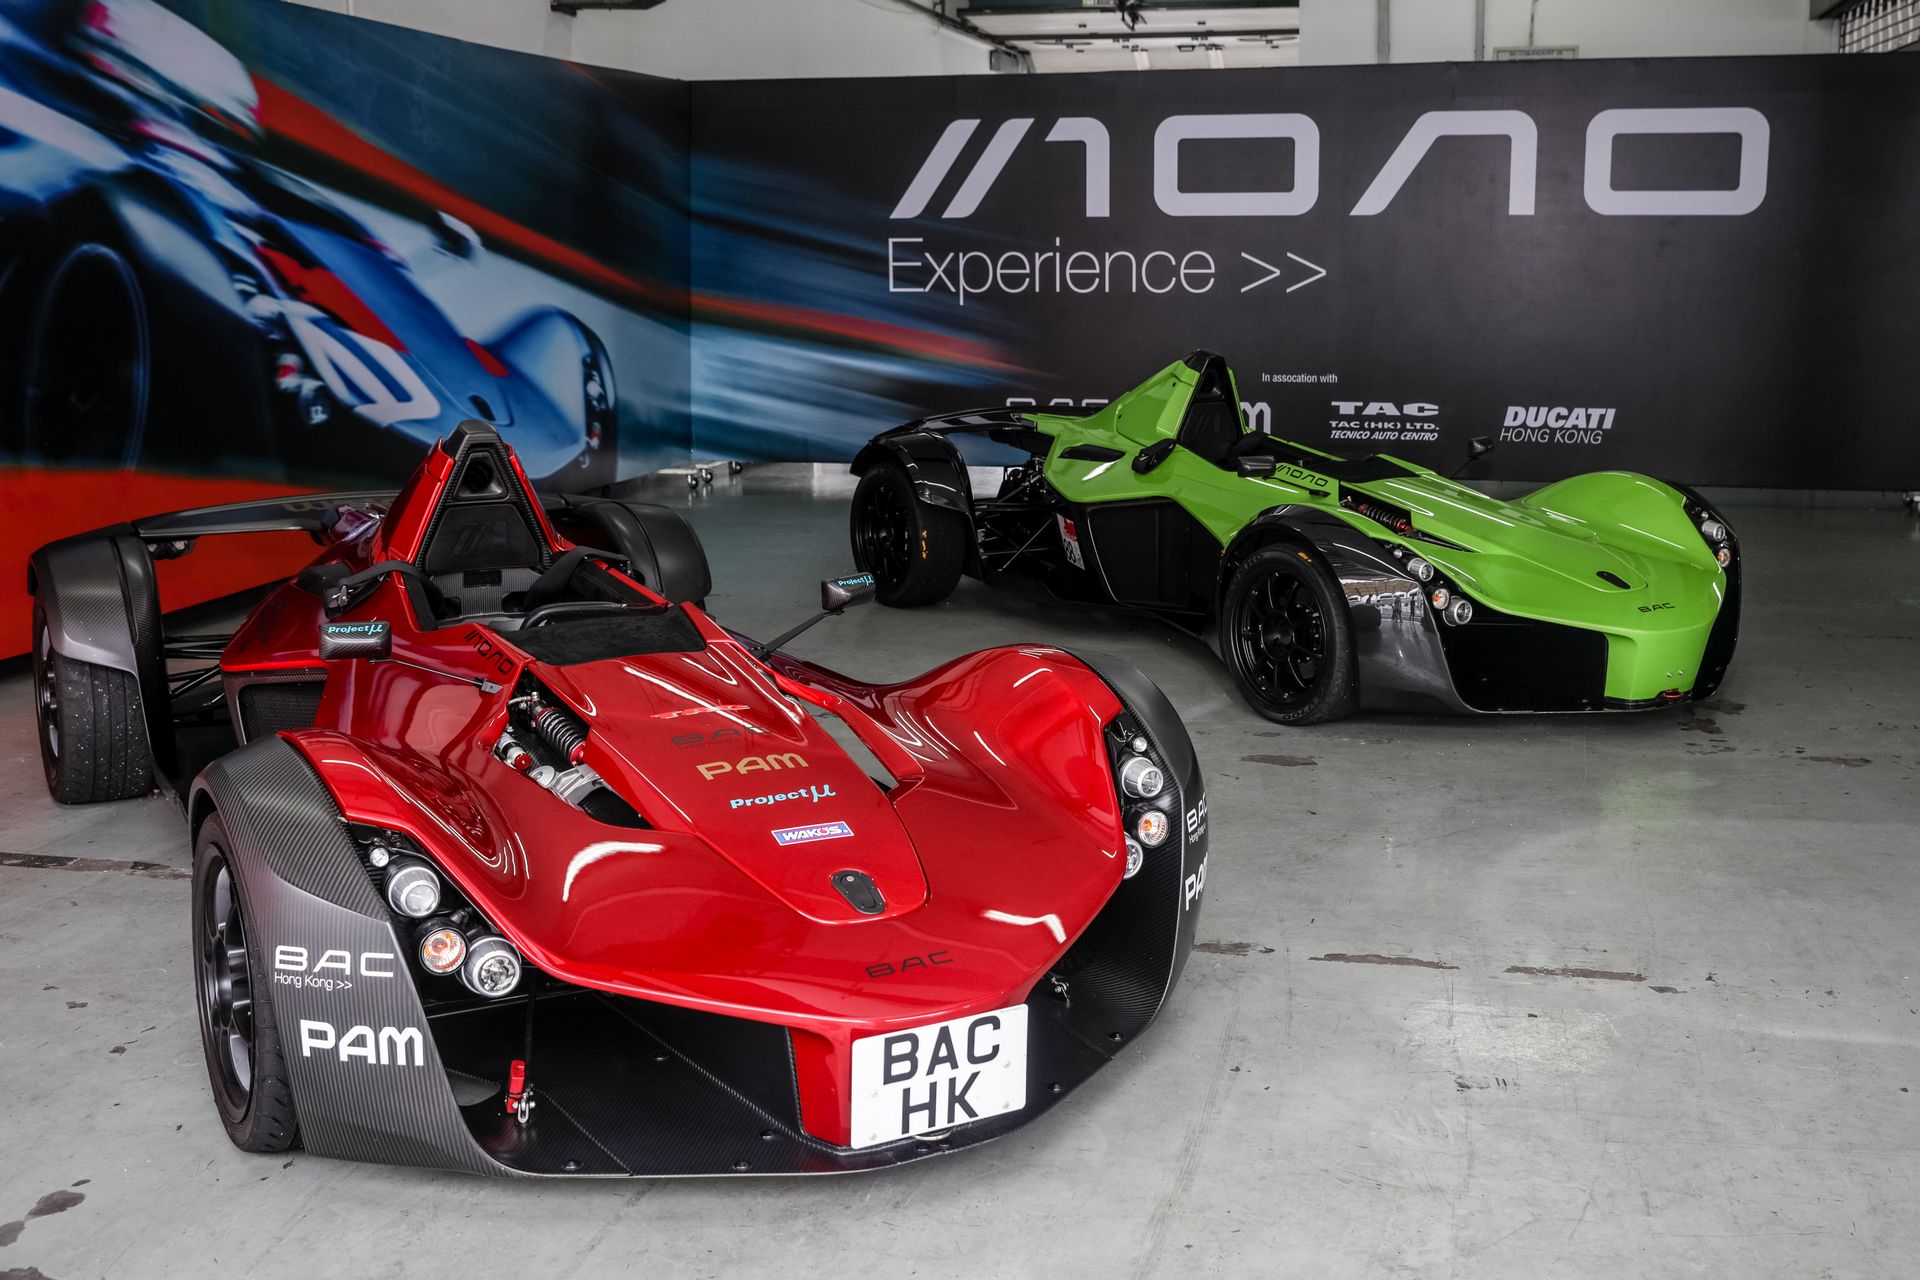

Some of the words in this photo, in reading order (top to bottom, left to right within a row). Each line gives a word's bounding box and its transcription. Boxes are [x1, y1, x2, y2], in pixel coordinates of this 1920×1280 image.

[888, 236, 1215, 306] Experience
[1262, 373, 1270, 382] In
[1319, 373, 1338, 383] with
[1331, 401, 1439, 416] TAC
[1503, 406, 1616, 429] DUCATI
[1329, 420, 1360, 428] TAC
[1364, 421, 1401, 429] (HK)
[1405, 422, 1440, 430] LTD.
[1330, 430, 1371, 440] TECNICO
[1371, 431, 1398, 440] AUTO
[1400, 432, 1438, 441] CENTRO
[1499, 428, 1550, 443] HONG
[1554, 429, 1603, 445] KONG
[1637, 602, 1676, 613] BAC
[696, 752, 809, 781] PAM
[275, 945, 394, 977] BAC
[865, 950, 954, 978] BAC
[274, 972, 302, 988] Hong
[305, 974, 333, 991] Kong
[300, 1019, 424, 1066] PAM
[883, 1015, 1001, 1085] BAC
[902, 1070, 981, 1135] HK
